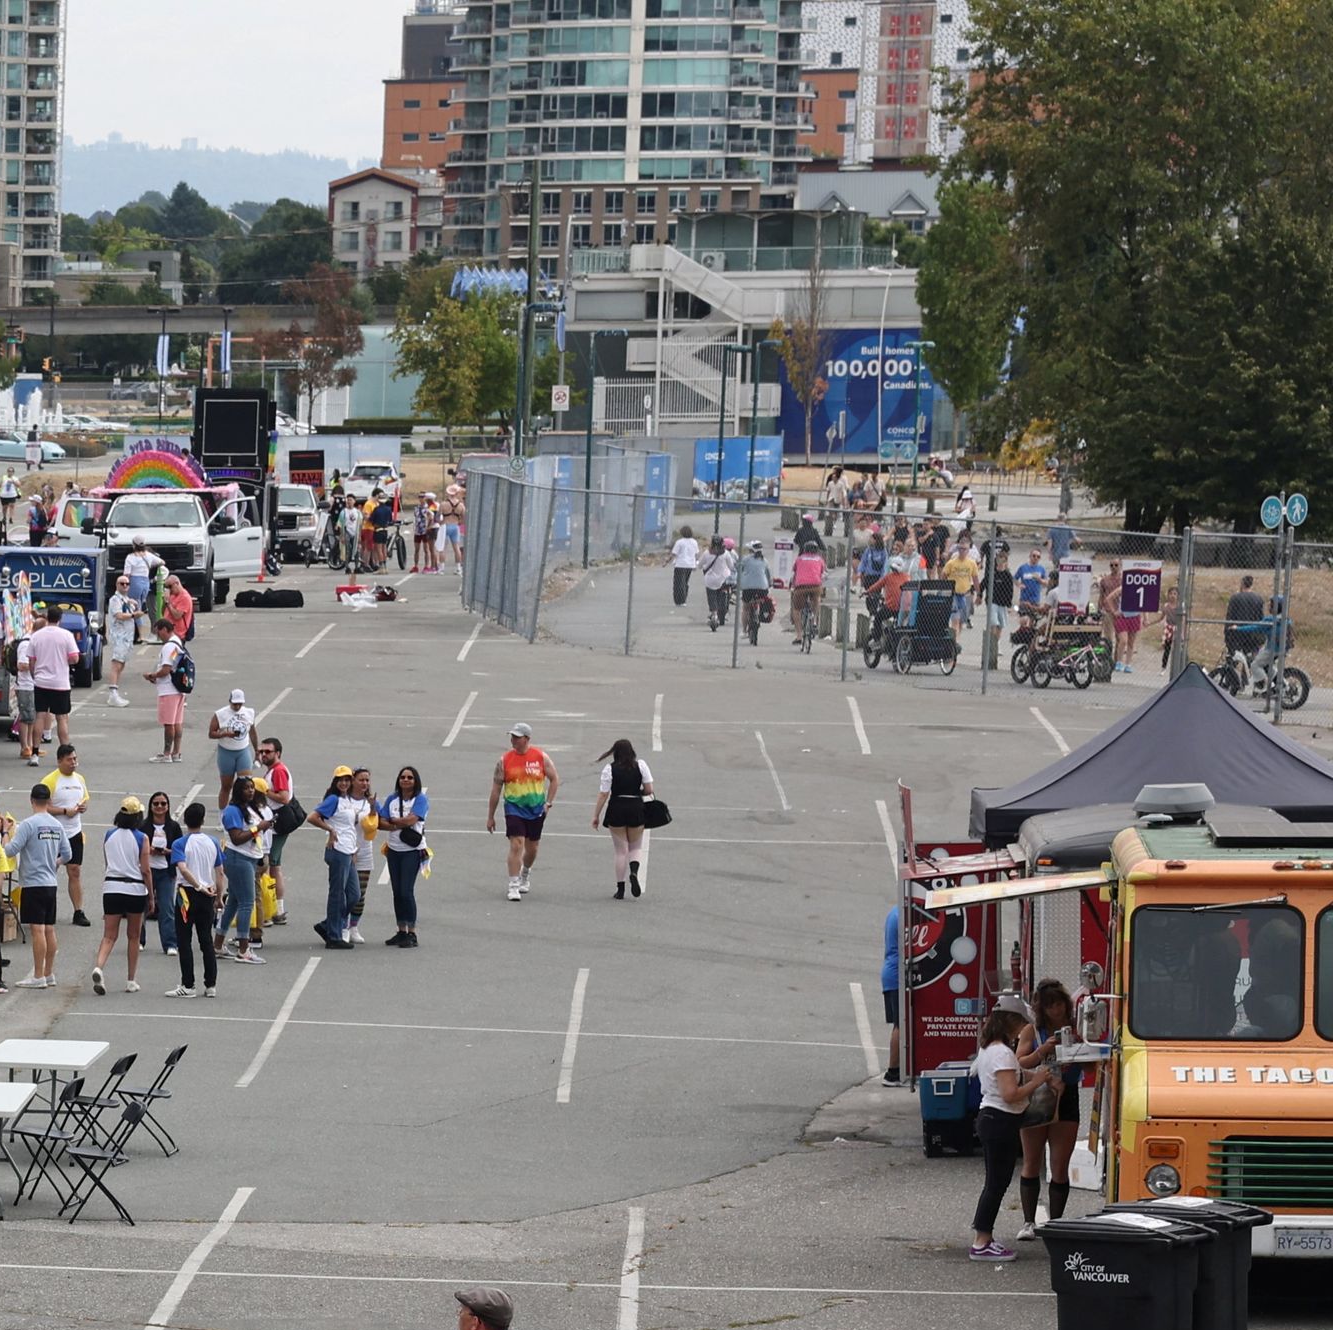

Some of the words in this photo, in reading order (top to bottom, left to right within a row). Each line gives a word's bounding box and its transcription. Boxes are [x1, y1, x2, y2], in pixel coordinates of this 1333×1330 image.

[885, 346, 915, 356] homes
[28, 572, 92, 588] PLACE
[1126, 574, 1156, 585] DOOR
[1136, 587, 1143, 608] 1
[1172, 1066, 1236, 1083] THE
[1246, 1066, 1333, 1084] TACO
[1080, 1264, 1095, 1272] CITY
[1072, 1272, 1130, 1284] VANCOUVER
